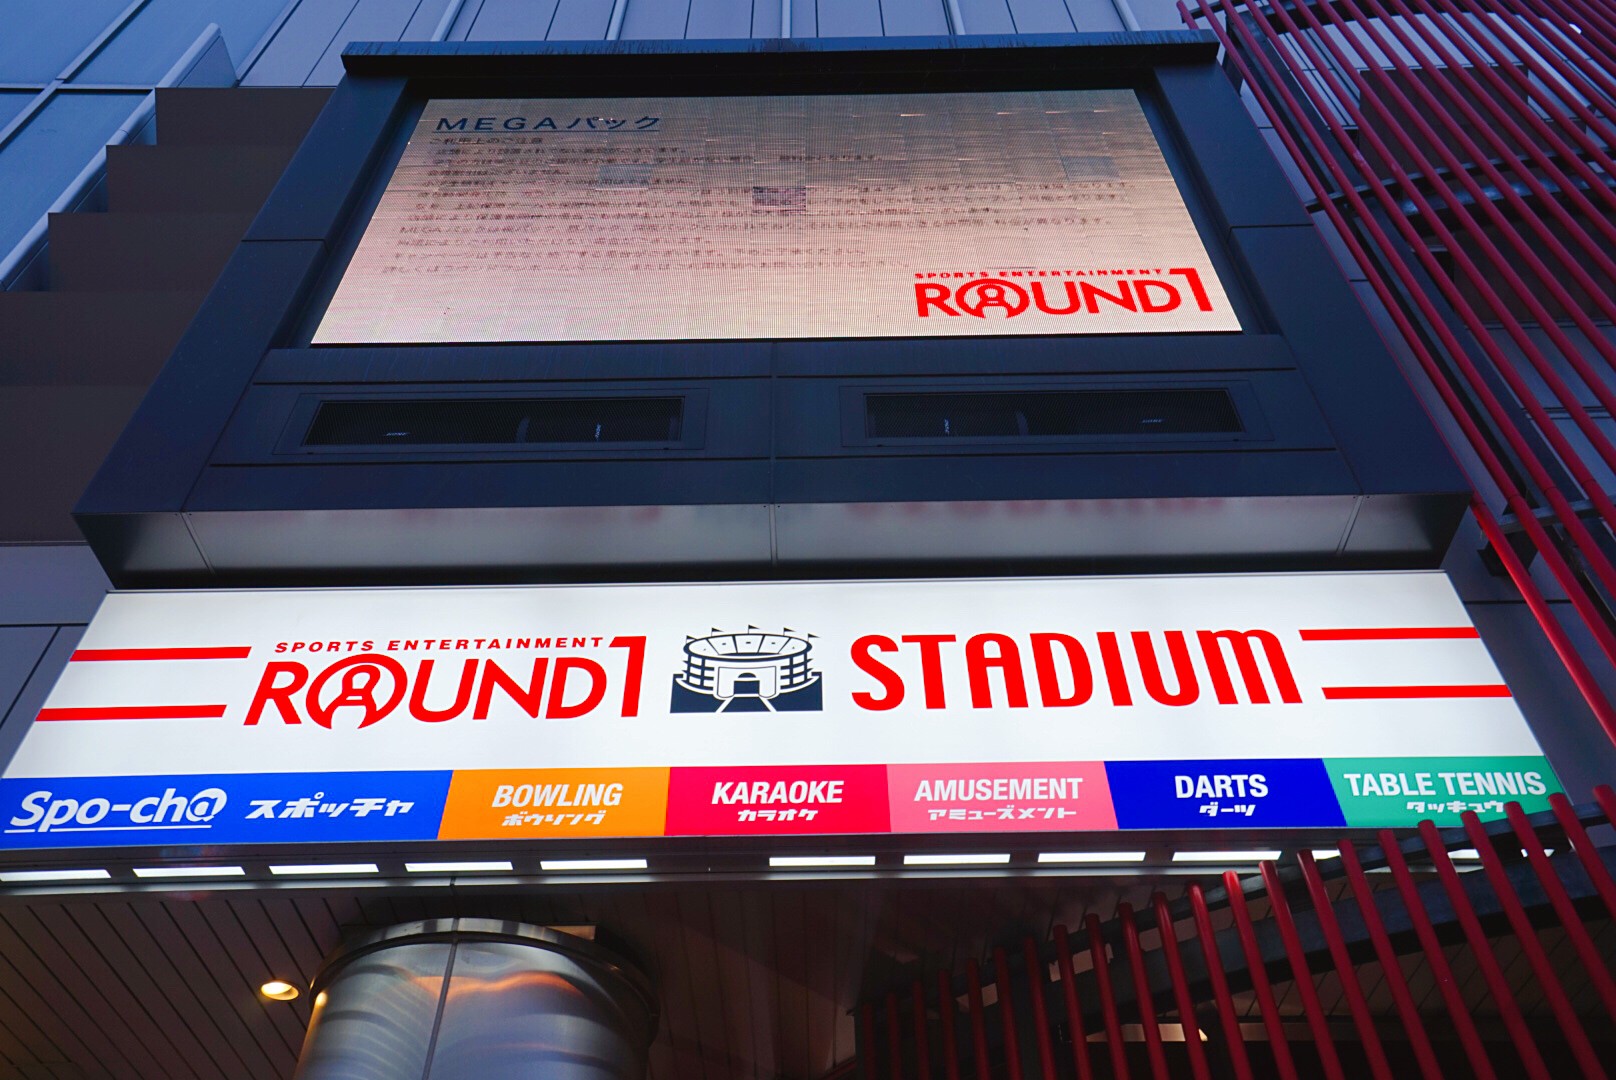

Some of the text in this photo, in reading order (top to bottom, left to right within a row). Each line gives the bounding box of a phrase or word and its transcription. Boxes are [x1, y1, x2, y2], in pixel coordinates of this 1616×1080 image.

[435, 115, 661, 131] MEGAパック
[914, 268, 1163, 280] SPORTS ENTERTAINMENT
[914, 267, 1214, 319] ROUND1
[274, 637, 604, 655] SPORTS ENTERTAINMENT
[850, 629, 1304, 711] STADIUM
[243, 636, 647, 730] ROUND1
[491, 783, 623, 808] BOWLING
[711, 780, 844, 805] KARAOKE
[913, 777, 1083, 802] AMUSEMENT
[1175, 774, 1268, 799] DARTS
[1343, 771, 1547, 796] TABLE TENNIS
[245, 791, 415, 819] スポッチャ
[736, 808, 819, 823] カラオケ
[926, 804, 1078, 821] アミューズメント
[1198, 801, 1257, 817] ダーツ
[1406, 800, 1504, 814] タッキュウ
[501, 810, 608, 827] ボウリング
